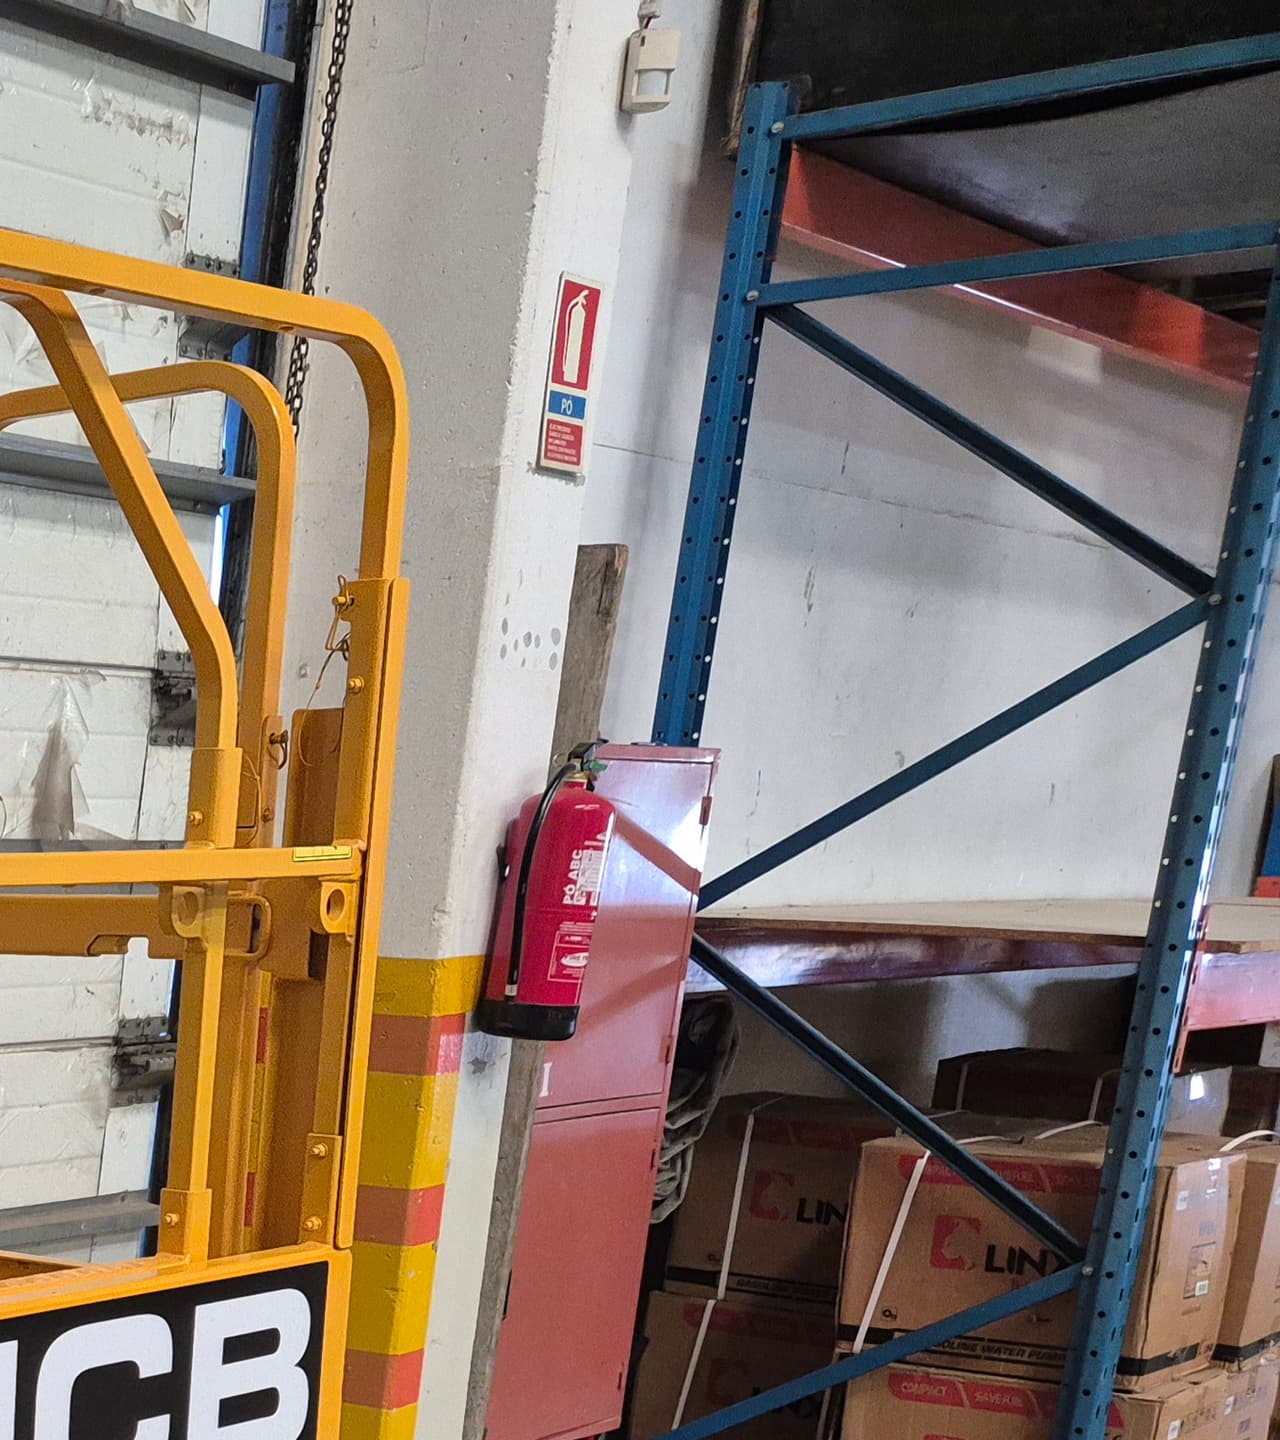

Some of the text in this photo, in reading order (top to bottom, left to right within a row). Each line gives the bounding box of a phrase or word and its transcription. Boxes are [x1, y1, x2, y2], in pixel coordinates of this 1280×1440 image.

[560, 396, 573, 415] PÓ
[562, 849, 582, 905] PÓ ABC
